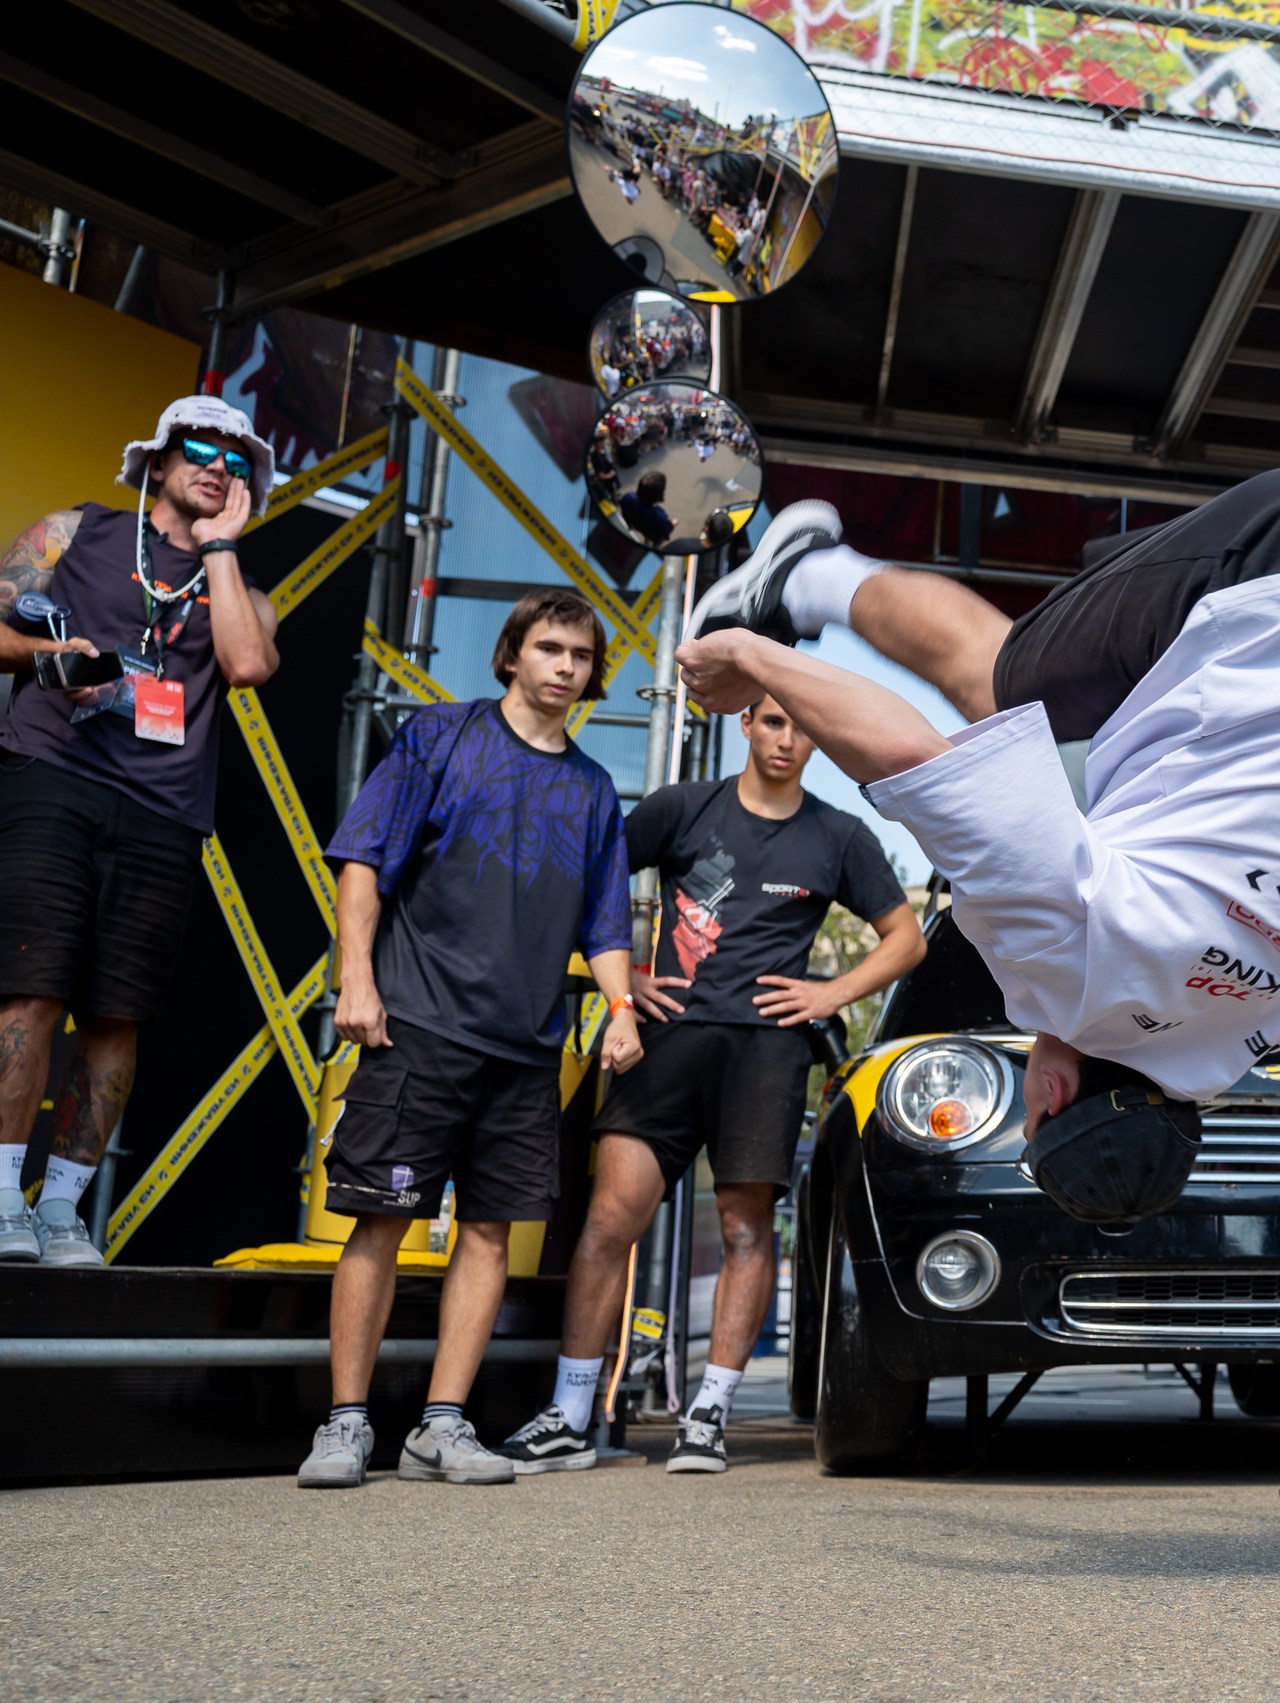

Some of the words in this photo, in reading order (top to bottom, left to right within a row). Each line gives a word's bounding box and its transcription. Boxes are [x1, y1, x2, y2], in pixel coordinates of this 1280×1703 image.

[256, 735, 295, 813] УВАЖЕНИЯ
[290, 815, 306, 836] ИЗ
[229, 902, 268, 979] УВАЖЕНИЯ
[262, 982, 278, 1003] ИЗ
[1185, 976, 1251, 1001] TOP
[221, 1074, 241, 1095] ИЗ
[167, 1094, 225, 1165] УВАЖЕНИЯ
[136, 1182, 156, 1204] ИЗ
